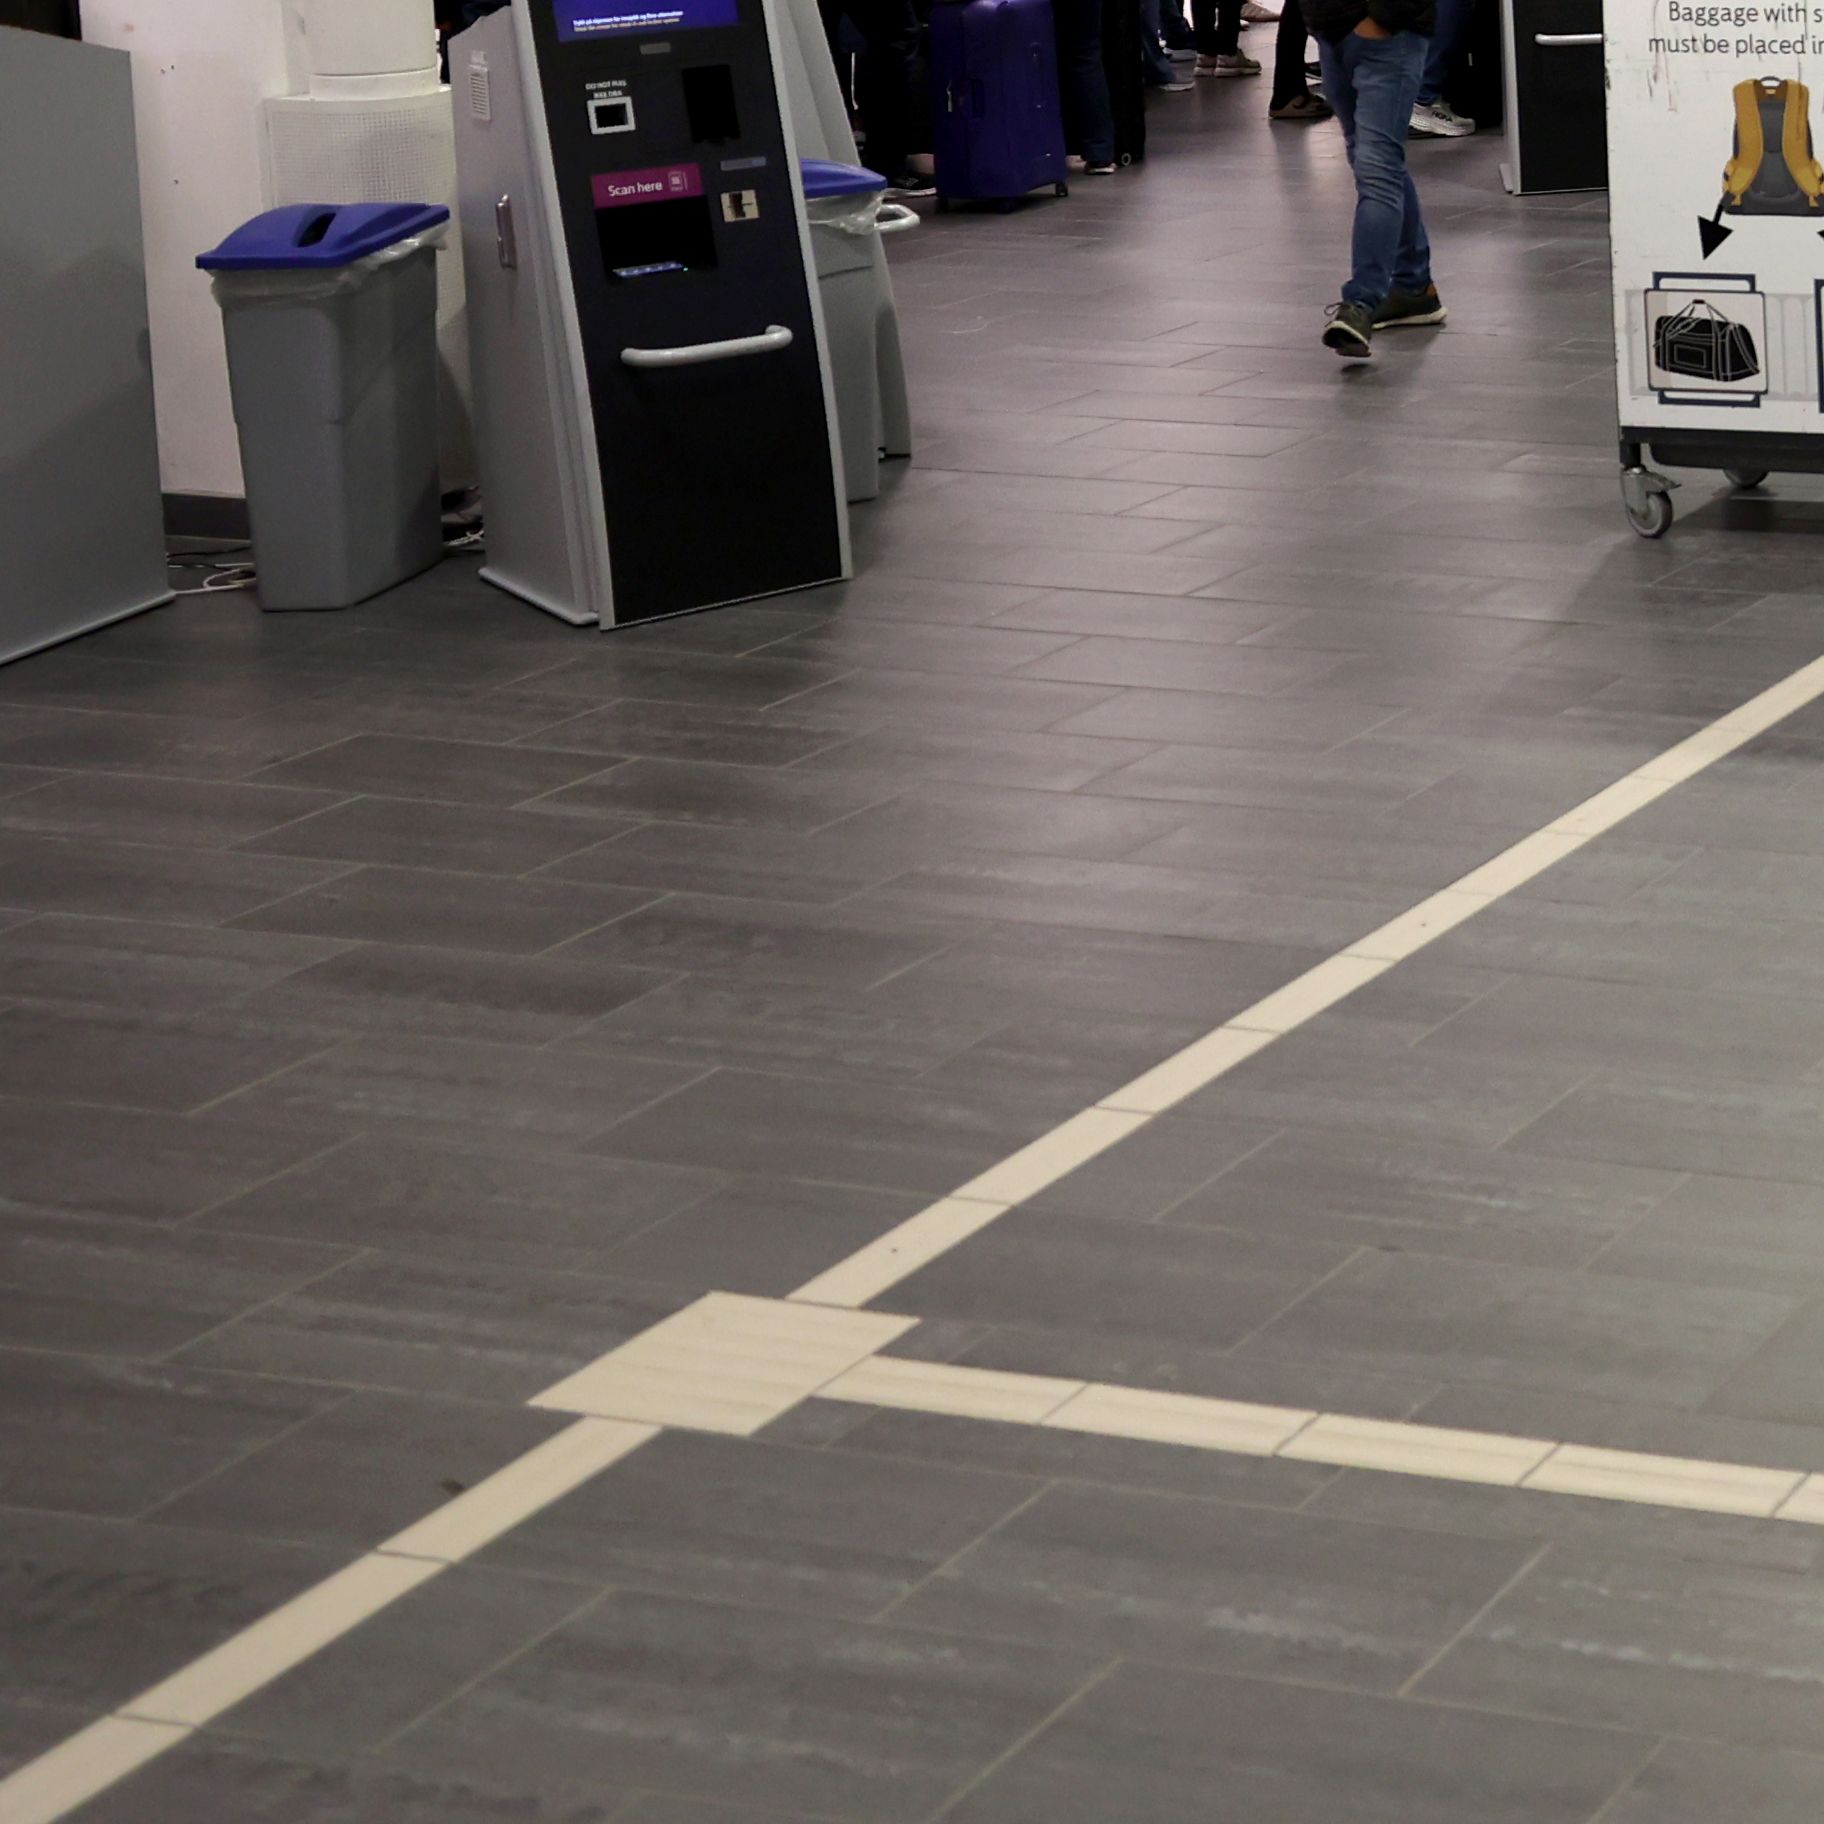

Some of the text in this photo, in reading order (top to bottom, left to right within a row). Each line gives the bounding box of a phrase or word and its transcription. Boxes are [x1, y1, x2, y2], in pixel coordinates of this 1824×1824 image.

[1669, 2, 1759, 26] Baggage
[1764, 3, 1806, 24] with
[1649, 36, 1699, 54] must
[1704, 35, 1729, 54] be
[1736, 35, 1806, 56] placed
[608, 182, 663, 196] Scan here
